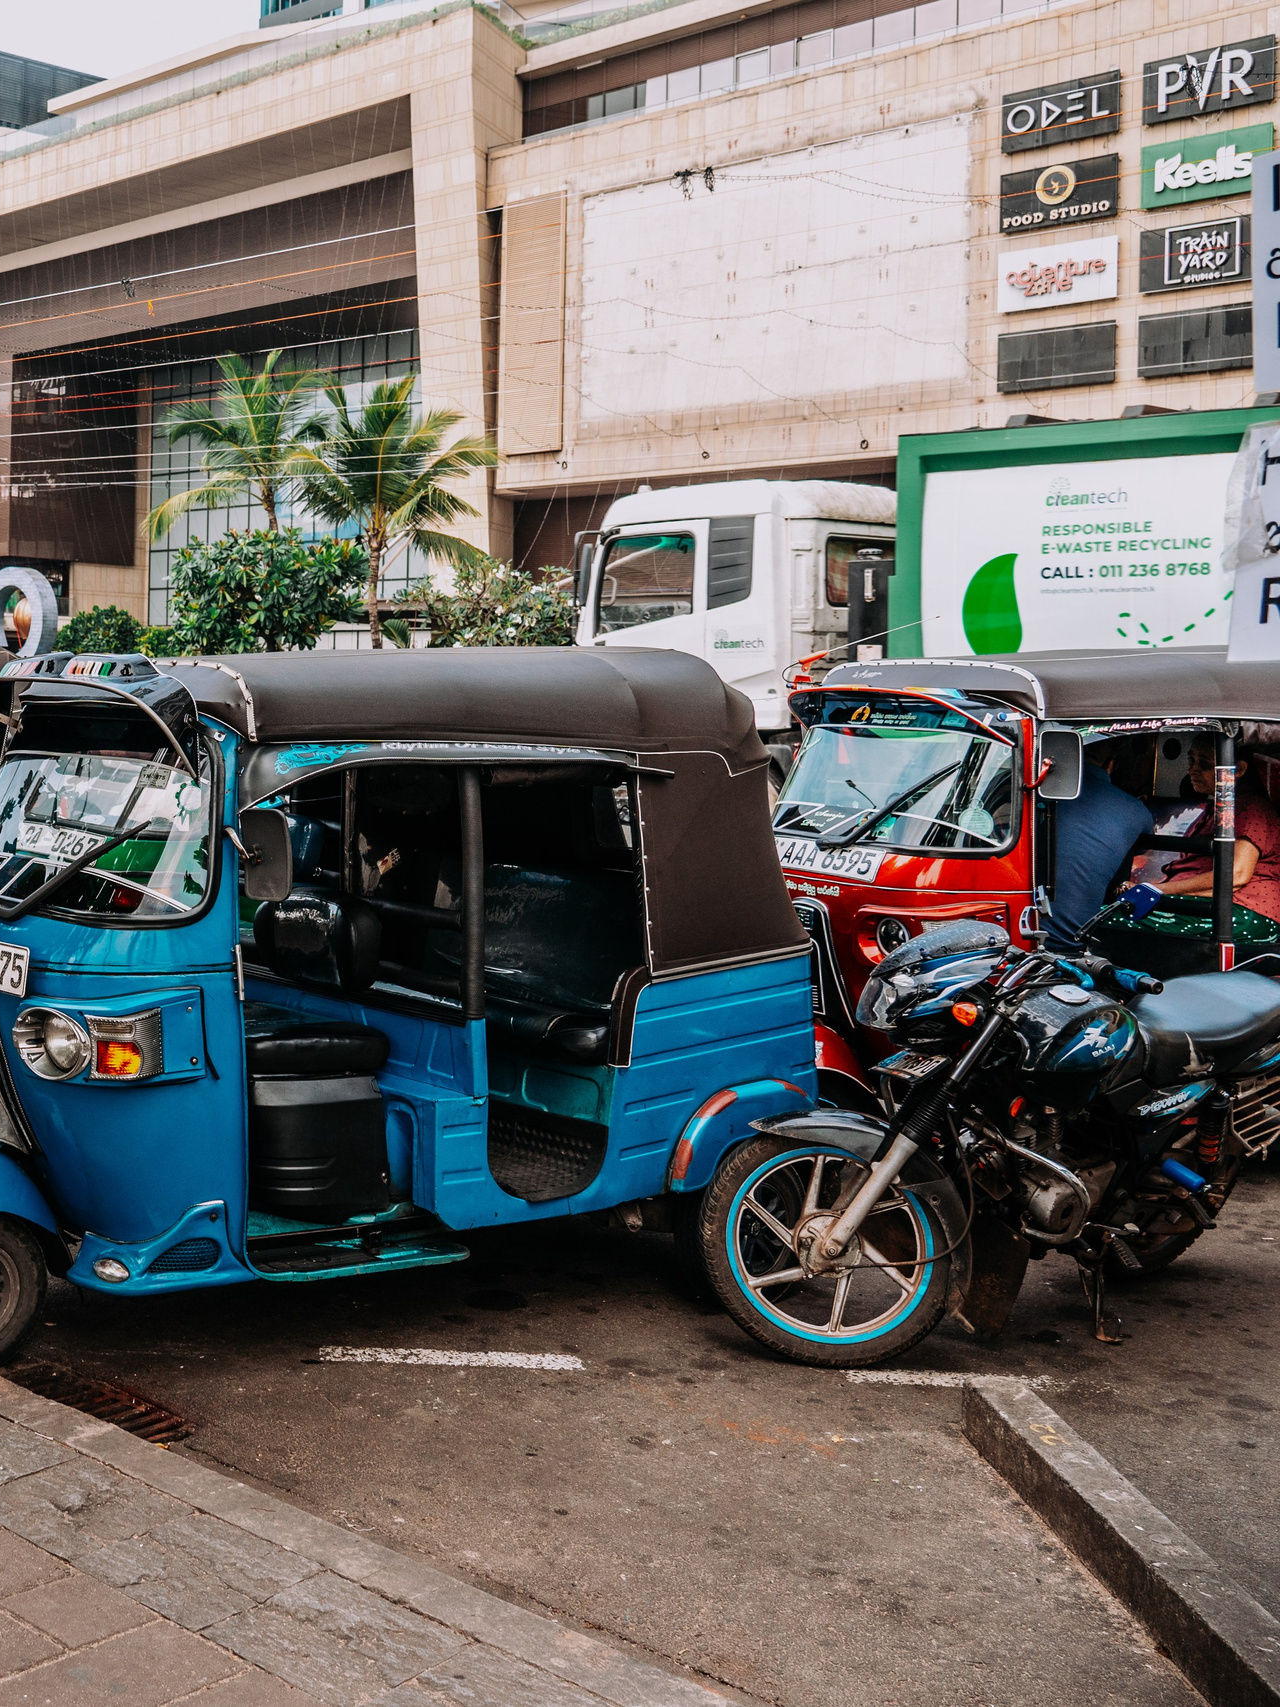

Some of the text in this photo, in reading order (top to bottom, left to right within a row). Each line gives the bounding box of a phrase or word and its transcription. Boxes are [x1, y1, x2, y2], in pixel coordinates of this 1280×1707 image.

[1157, 47, 1254, 113] PVR
[1006, 89, 1110, 134] ODEL
[1154, 144, 1253, 193] Keells
[1002, 200, 1110, 228] FOOD STUDIO
[1006, 258, 1106, 287] adventure
[1178, 251, 1228, 274] YARD
[1024, 276, 1073, 297] zone
[1046, 487, 1128, 507] cleantech
[1042, 521, 1153, 536] RESPONSIBLE
[1041, 537, 1211, 554] E-WASTE RECYCLING
[1041, 566, 1084, 579] CALL
[1099, 565, 1123, 578] 011
[1128, 564, 1160, 577] 236
[1166, 562, 1211, 576] 8768
[714, 637, 765, 649] cleantech
[1087, 717, 1208, 733] Love Makes Life Beautiful
[780, 842, 877, 876] AAA 6595
[1091, 1044, 1116, 1058] BAJAJ
